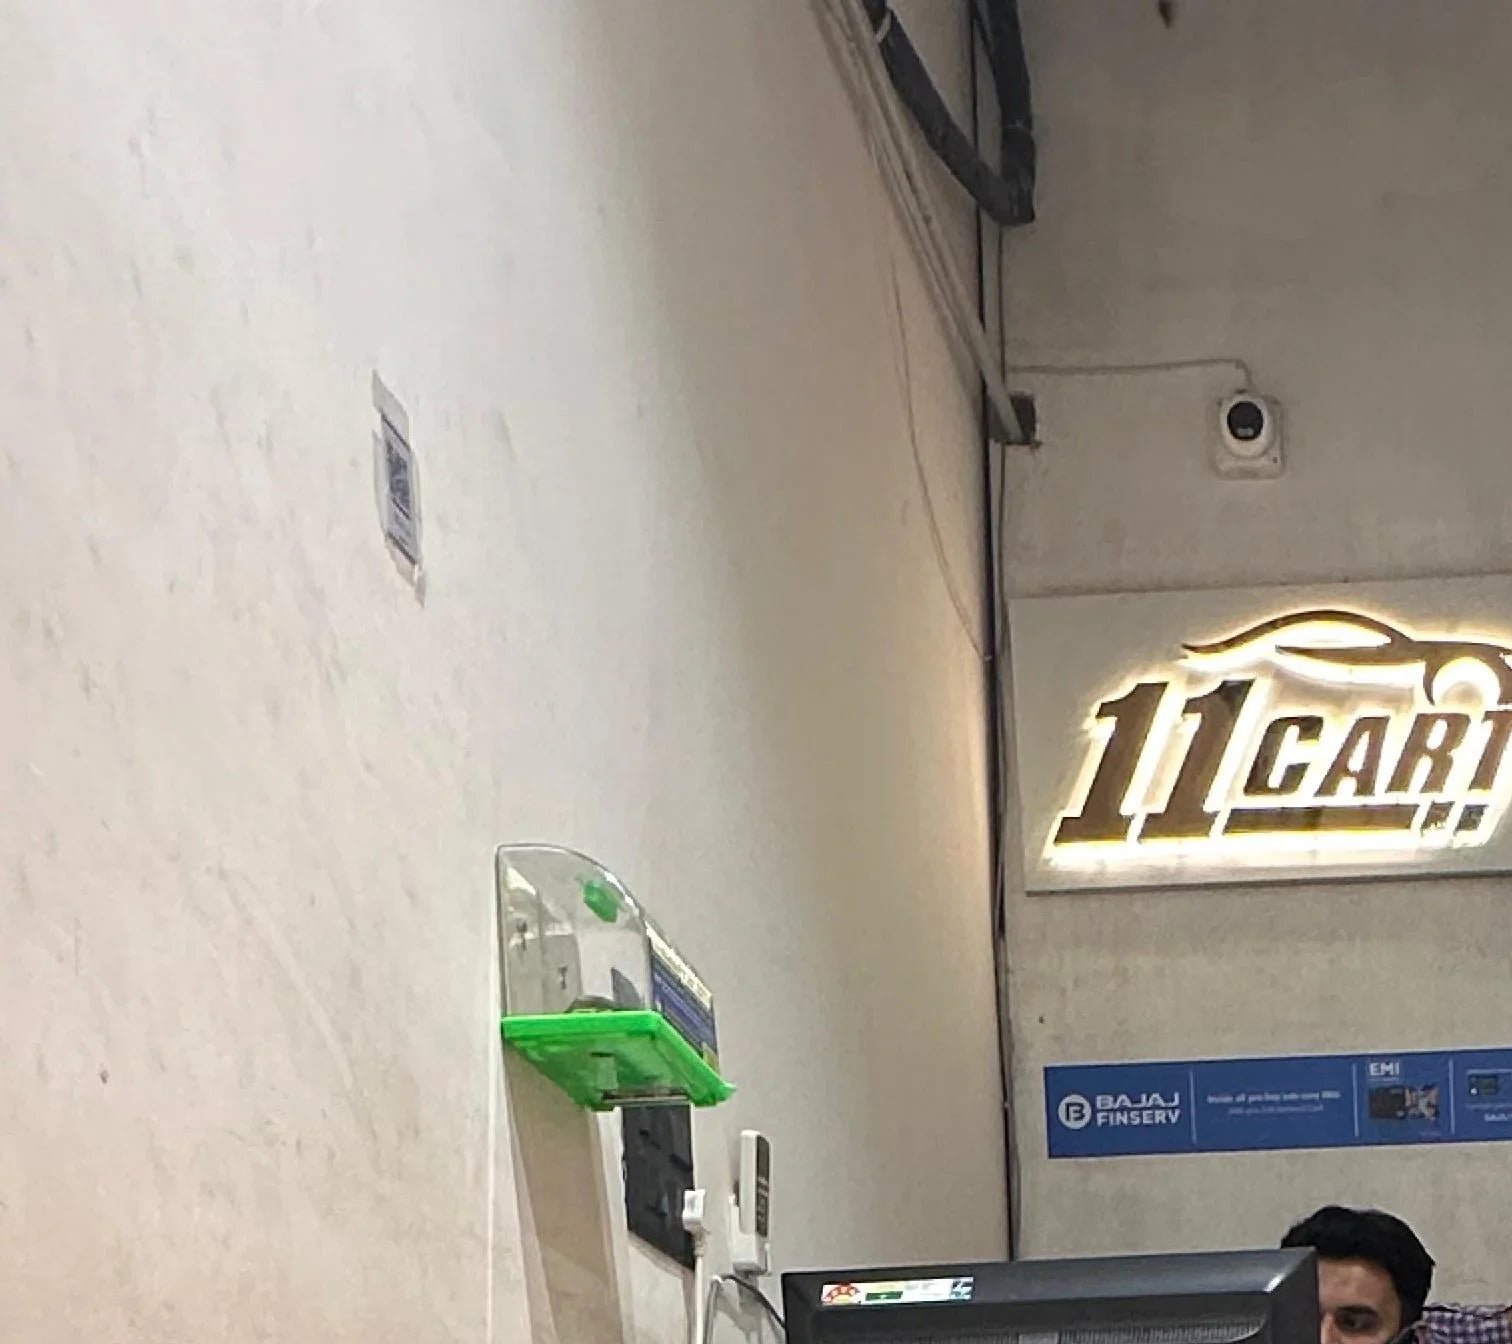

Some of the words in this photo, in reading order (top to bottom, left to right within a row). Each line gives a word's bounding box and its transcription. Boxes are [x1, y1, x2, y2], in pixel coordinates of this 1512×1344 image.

[1053, 678, 1256, 847] 11
[1369, 1062, 1400, 1076] EMI
[1096, 1092, 1180, 1110] BAJAJ
[1096, 1108, 1181, 1127] FINSERV
